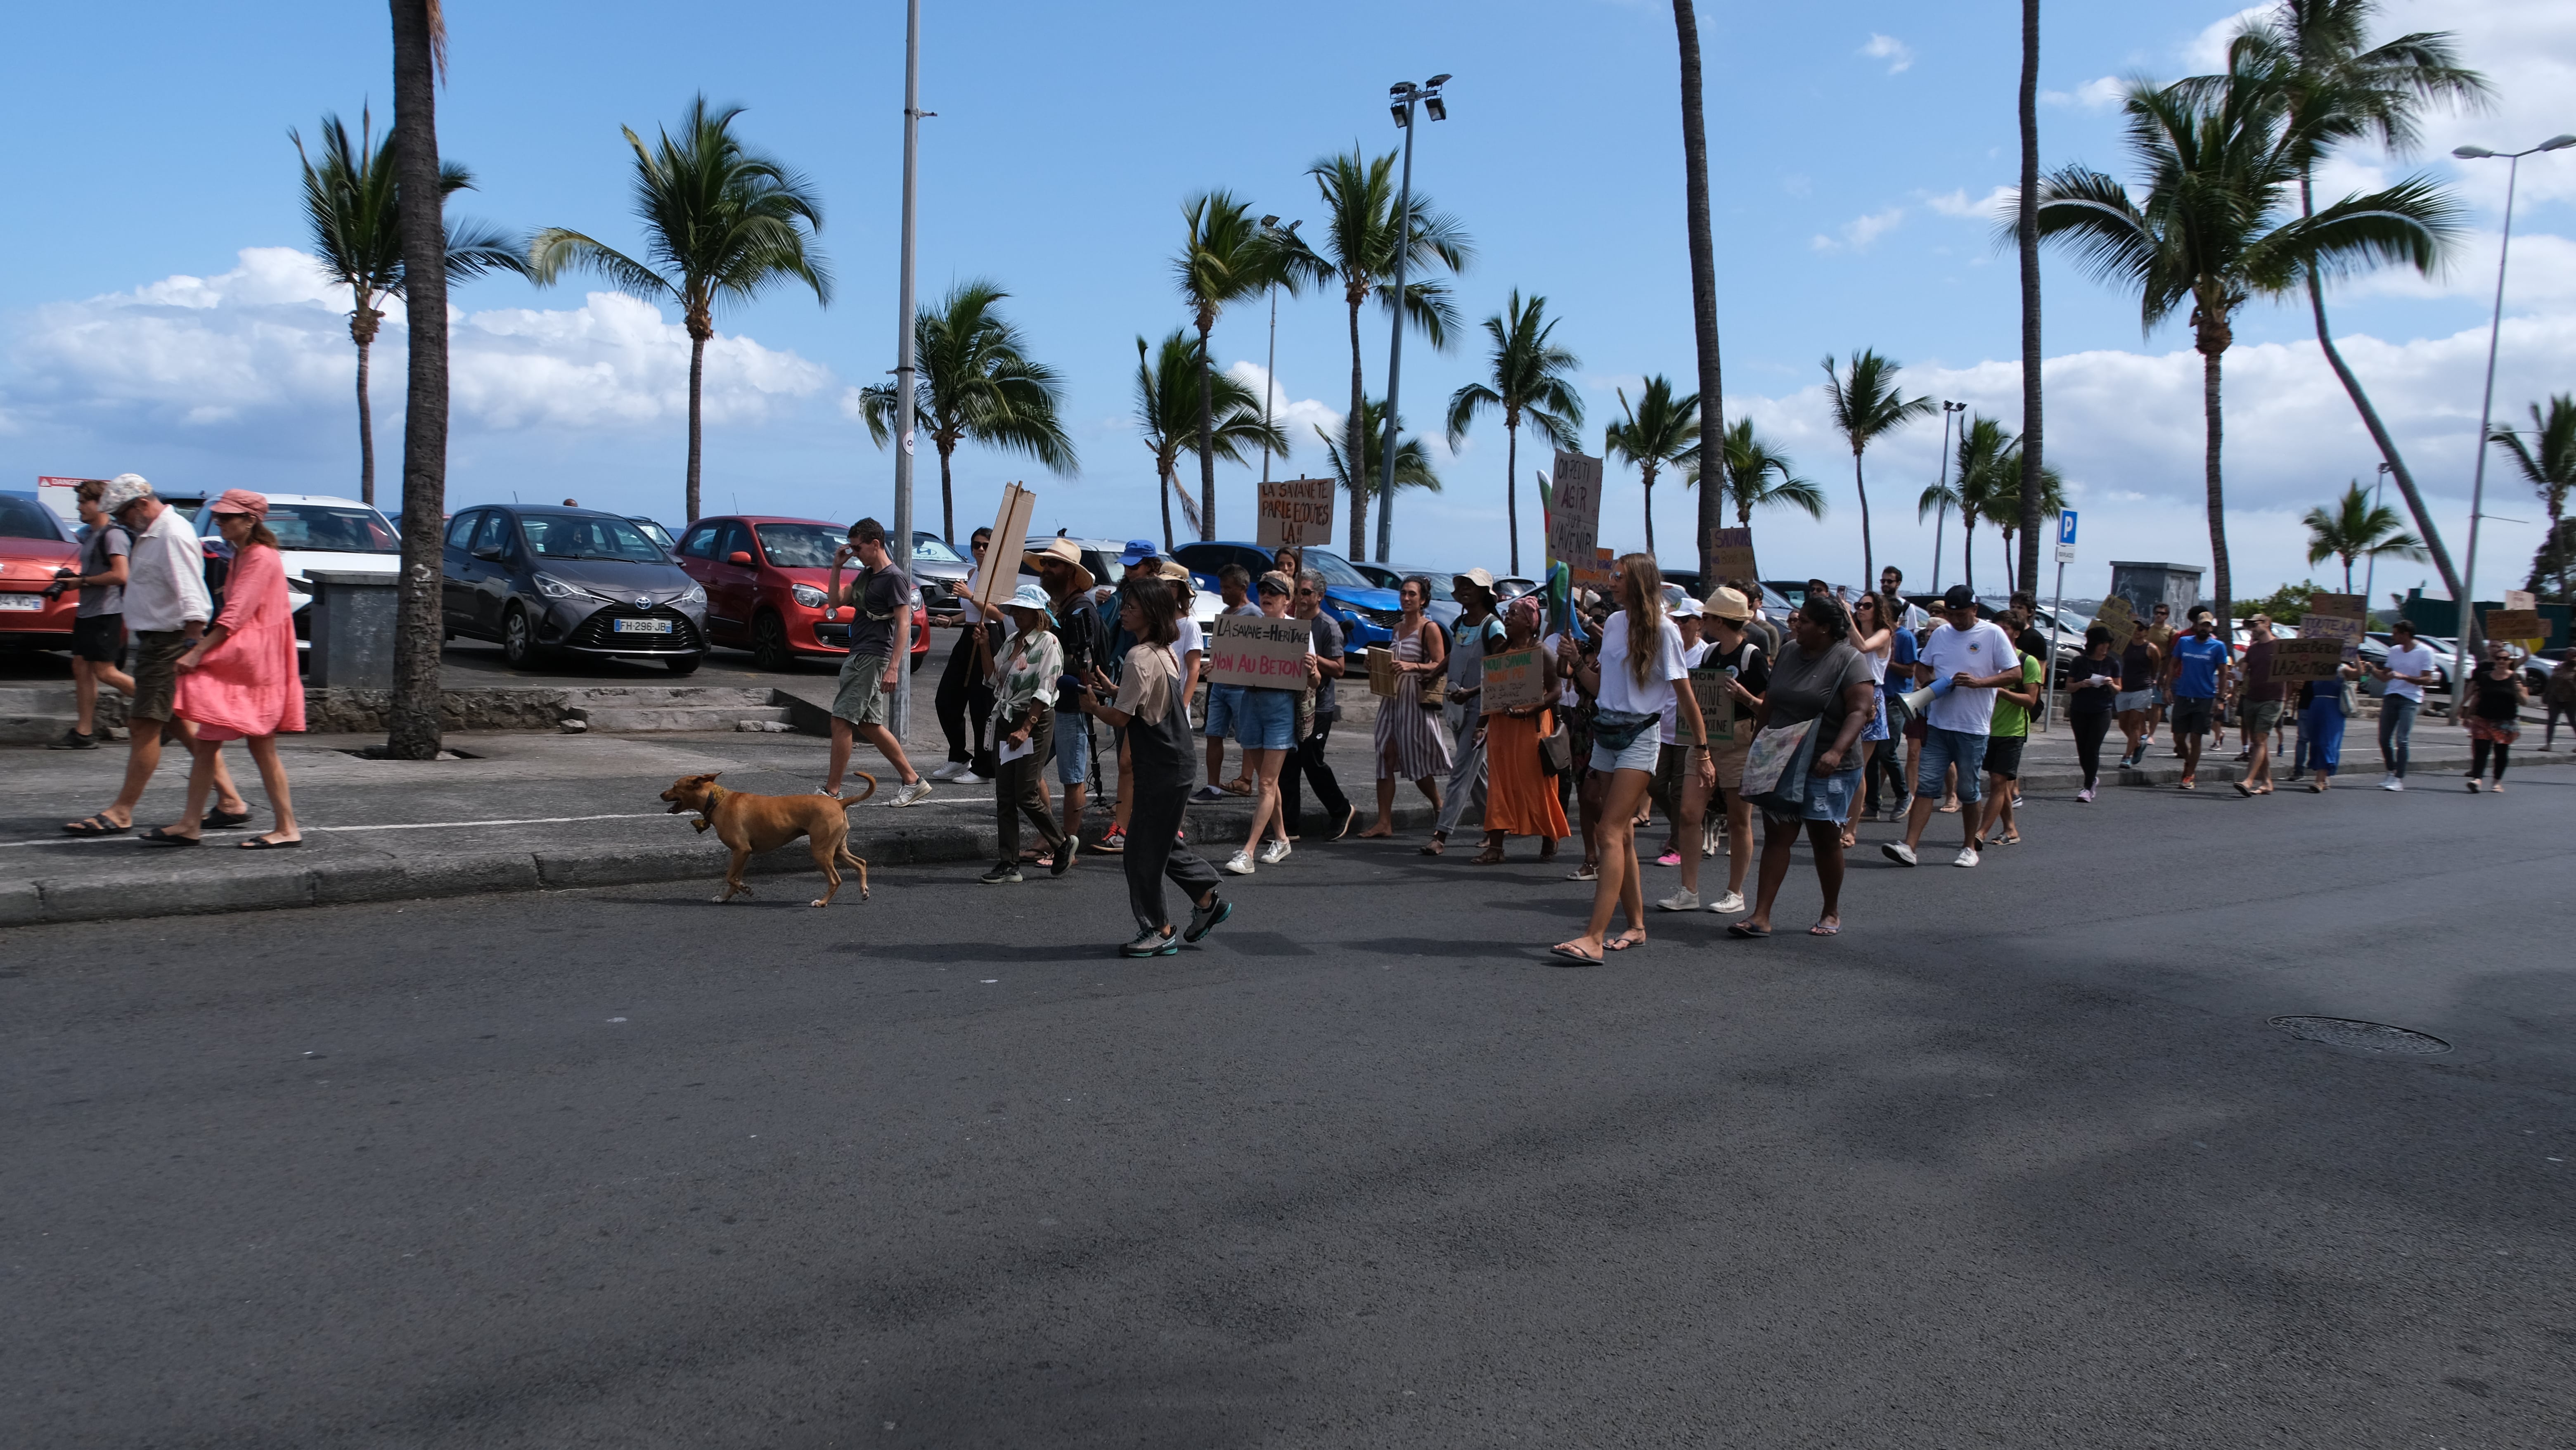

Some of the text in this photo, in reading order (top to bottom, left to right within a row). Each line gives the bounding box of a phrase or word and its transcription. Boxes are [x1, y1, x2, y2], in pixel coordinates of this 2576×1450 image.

[1262, 480, 1328, 499] LA SAVANE TE
[1262, 500, 1291, 519] PARLE
[620, 621, 665, 631] FH-296-JB
[1217, 618, 1231, 637] LA
[1232, 624, 1262, 639] SAVANE
[1237, 654, 1256, 673] AU
[1260, 655, 1304, 678] BETON
[1693, 684, 1723, 707] VANE
